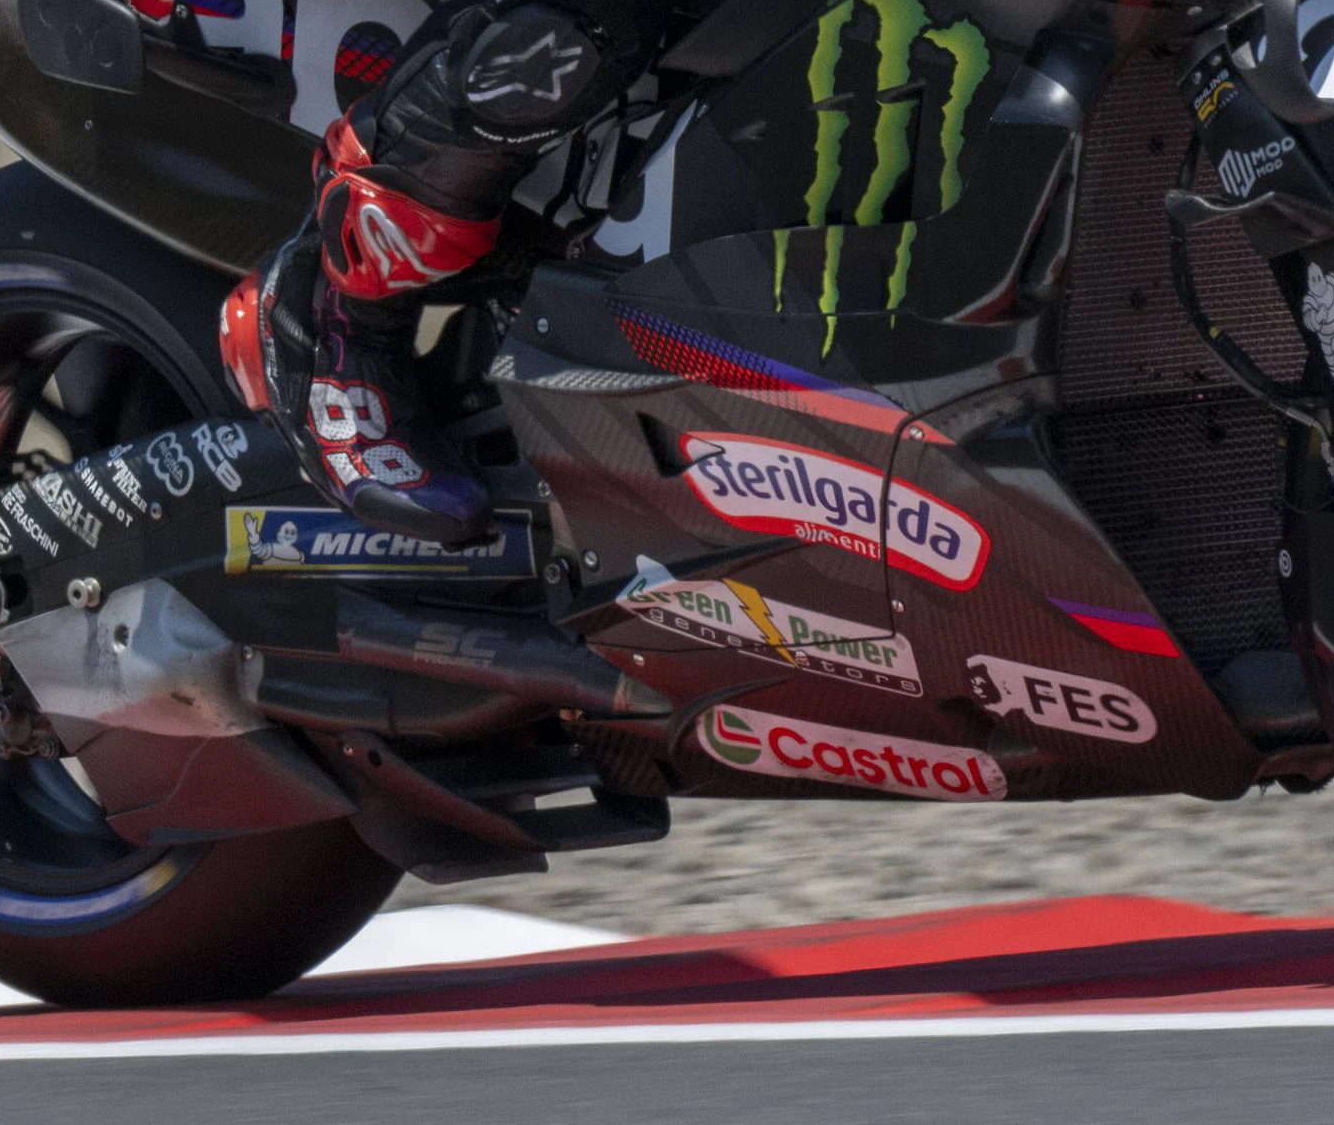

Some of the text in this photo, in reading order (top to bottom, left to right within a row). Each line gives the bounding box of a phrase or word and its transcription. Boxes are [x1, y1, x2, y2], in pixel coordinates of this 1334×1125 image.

[1251, 136, 1296, 165] MOD
[1255, 158, 1283, 177] MOD
[113, 457, 142, 493] SPRINT
[192, 423, 242, 492] RCB
[80, 467, 134, 528] SHAREBOT
[112, 471, 148, 513] FILTER
[697, 454, 961, 561] sterilgarda
[1, 491, 59, 557] REFRASCHINI
[310, 532, 506, 558] MICHEN
[794, 522, 881, 560] alimenti
[627, 577, 898, 669] Green Power
[1023, 676, 1140, 733] FES
[768, 726, 989, 795] Castrol
